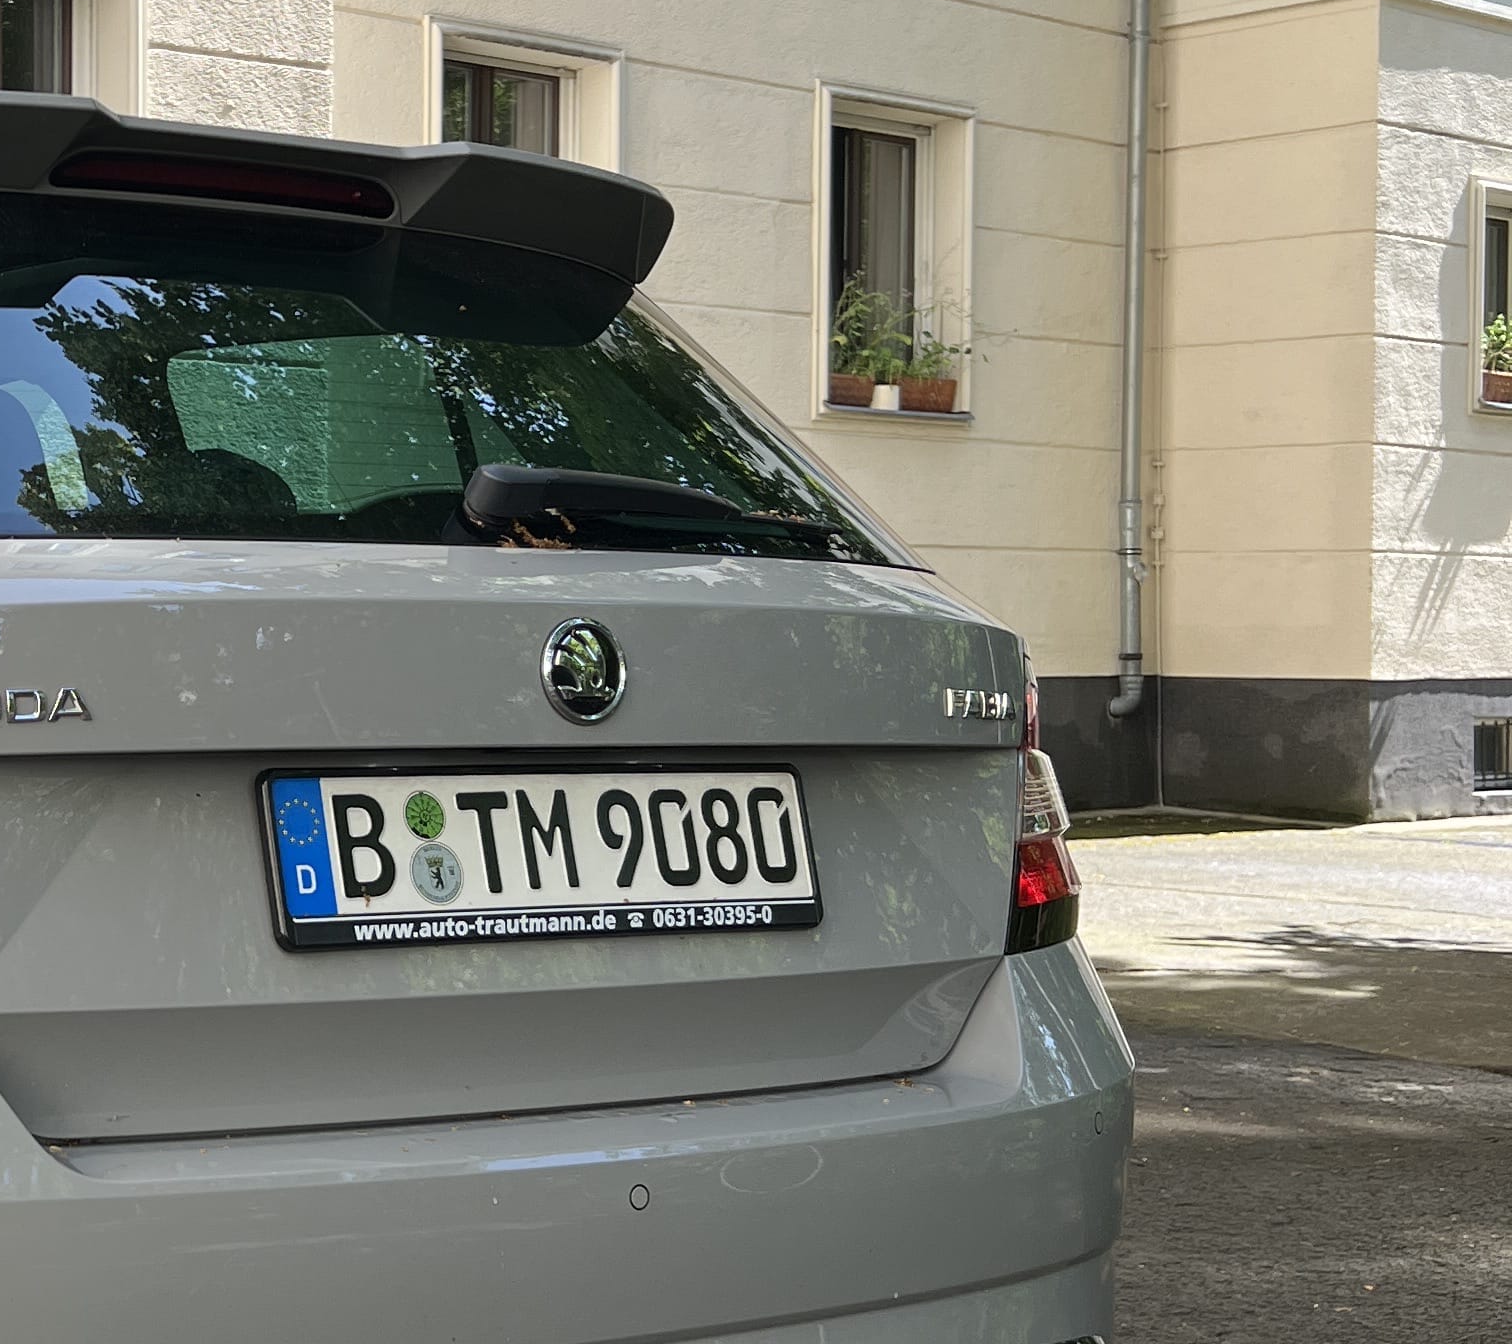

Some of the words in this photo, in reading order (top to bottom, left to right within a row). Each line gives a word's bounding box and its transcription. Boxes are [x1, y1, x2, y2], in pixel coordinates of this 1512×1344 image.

[943, 687, 1016, 720] FABIA
[331, 793, 396, 898] B
[455, 789, 580, 893] TM
[596, 787, 796, 888] 9080
[295, 864, 317, 895] D
[354, 910, 617, 941] www.auto-trautmann.de
[652, 905, 773, 929] 0631-30395-0
